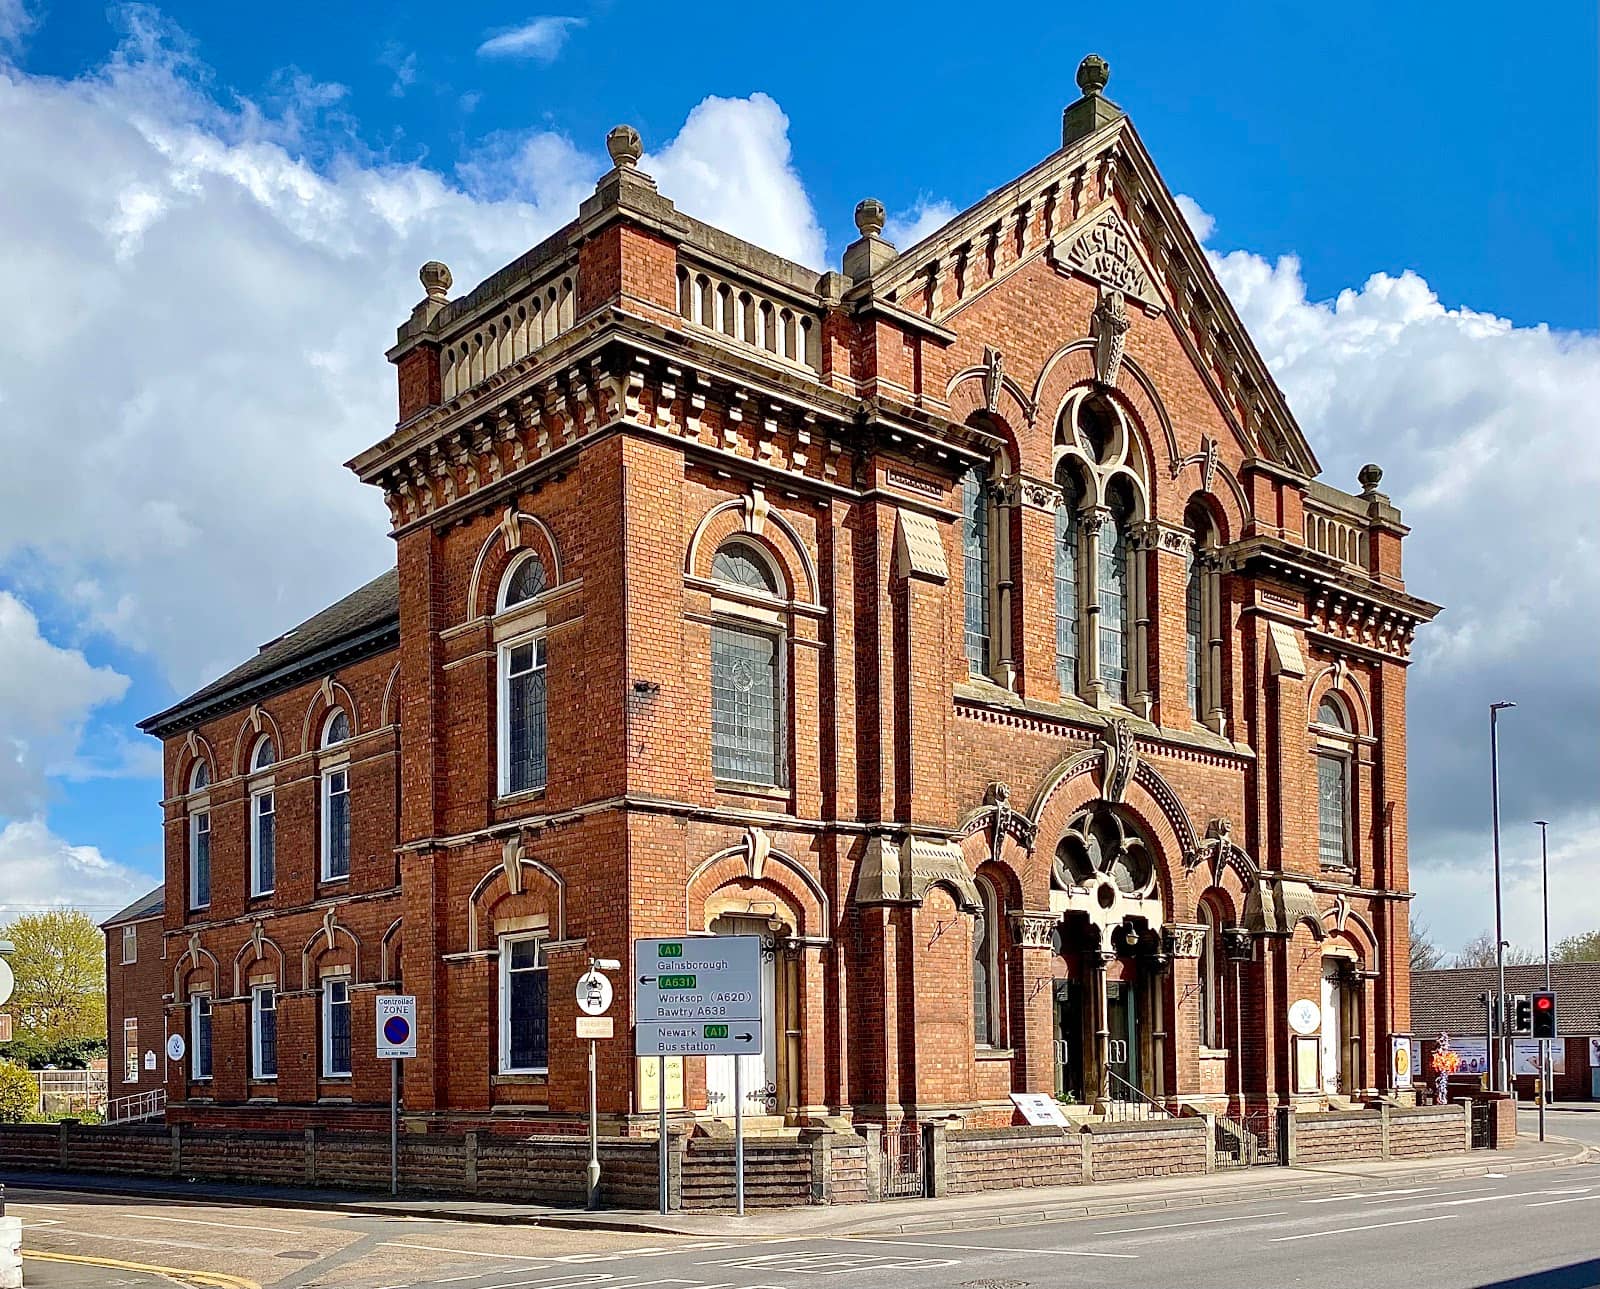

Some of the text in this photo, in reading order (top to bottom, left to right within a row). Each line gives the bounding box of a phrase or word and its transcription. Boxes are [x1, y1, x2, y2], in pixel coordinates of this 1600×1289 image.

[659, 944, 682, 956] (A1)
[657, 960, 728, 971] Gainsborough
[659, 976, 696, 988] (A631)
[378, 997, 414, 1005] Controlled
[658, 991, 752, 1004] Worksop (A620)
[383, 1006, 409, 1014] ZONE
[657, 1006, 726, 1018] Bawtry A638
[658, 1026, 728, 1038] Newark (A1)
[658, 1041, 716, 1051] Bus station
[692, 1251, 962, 1275] KEEP
